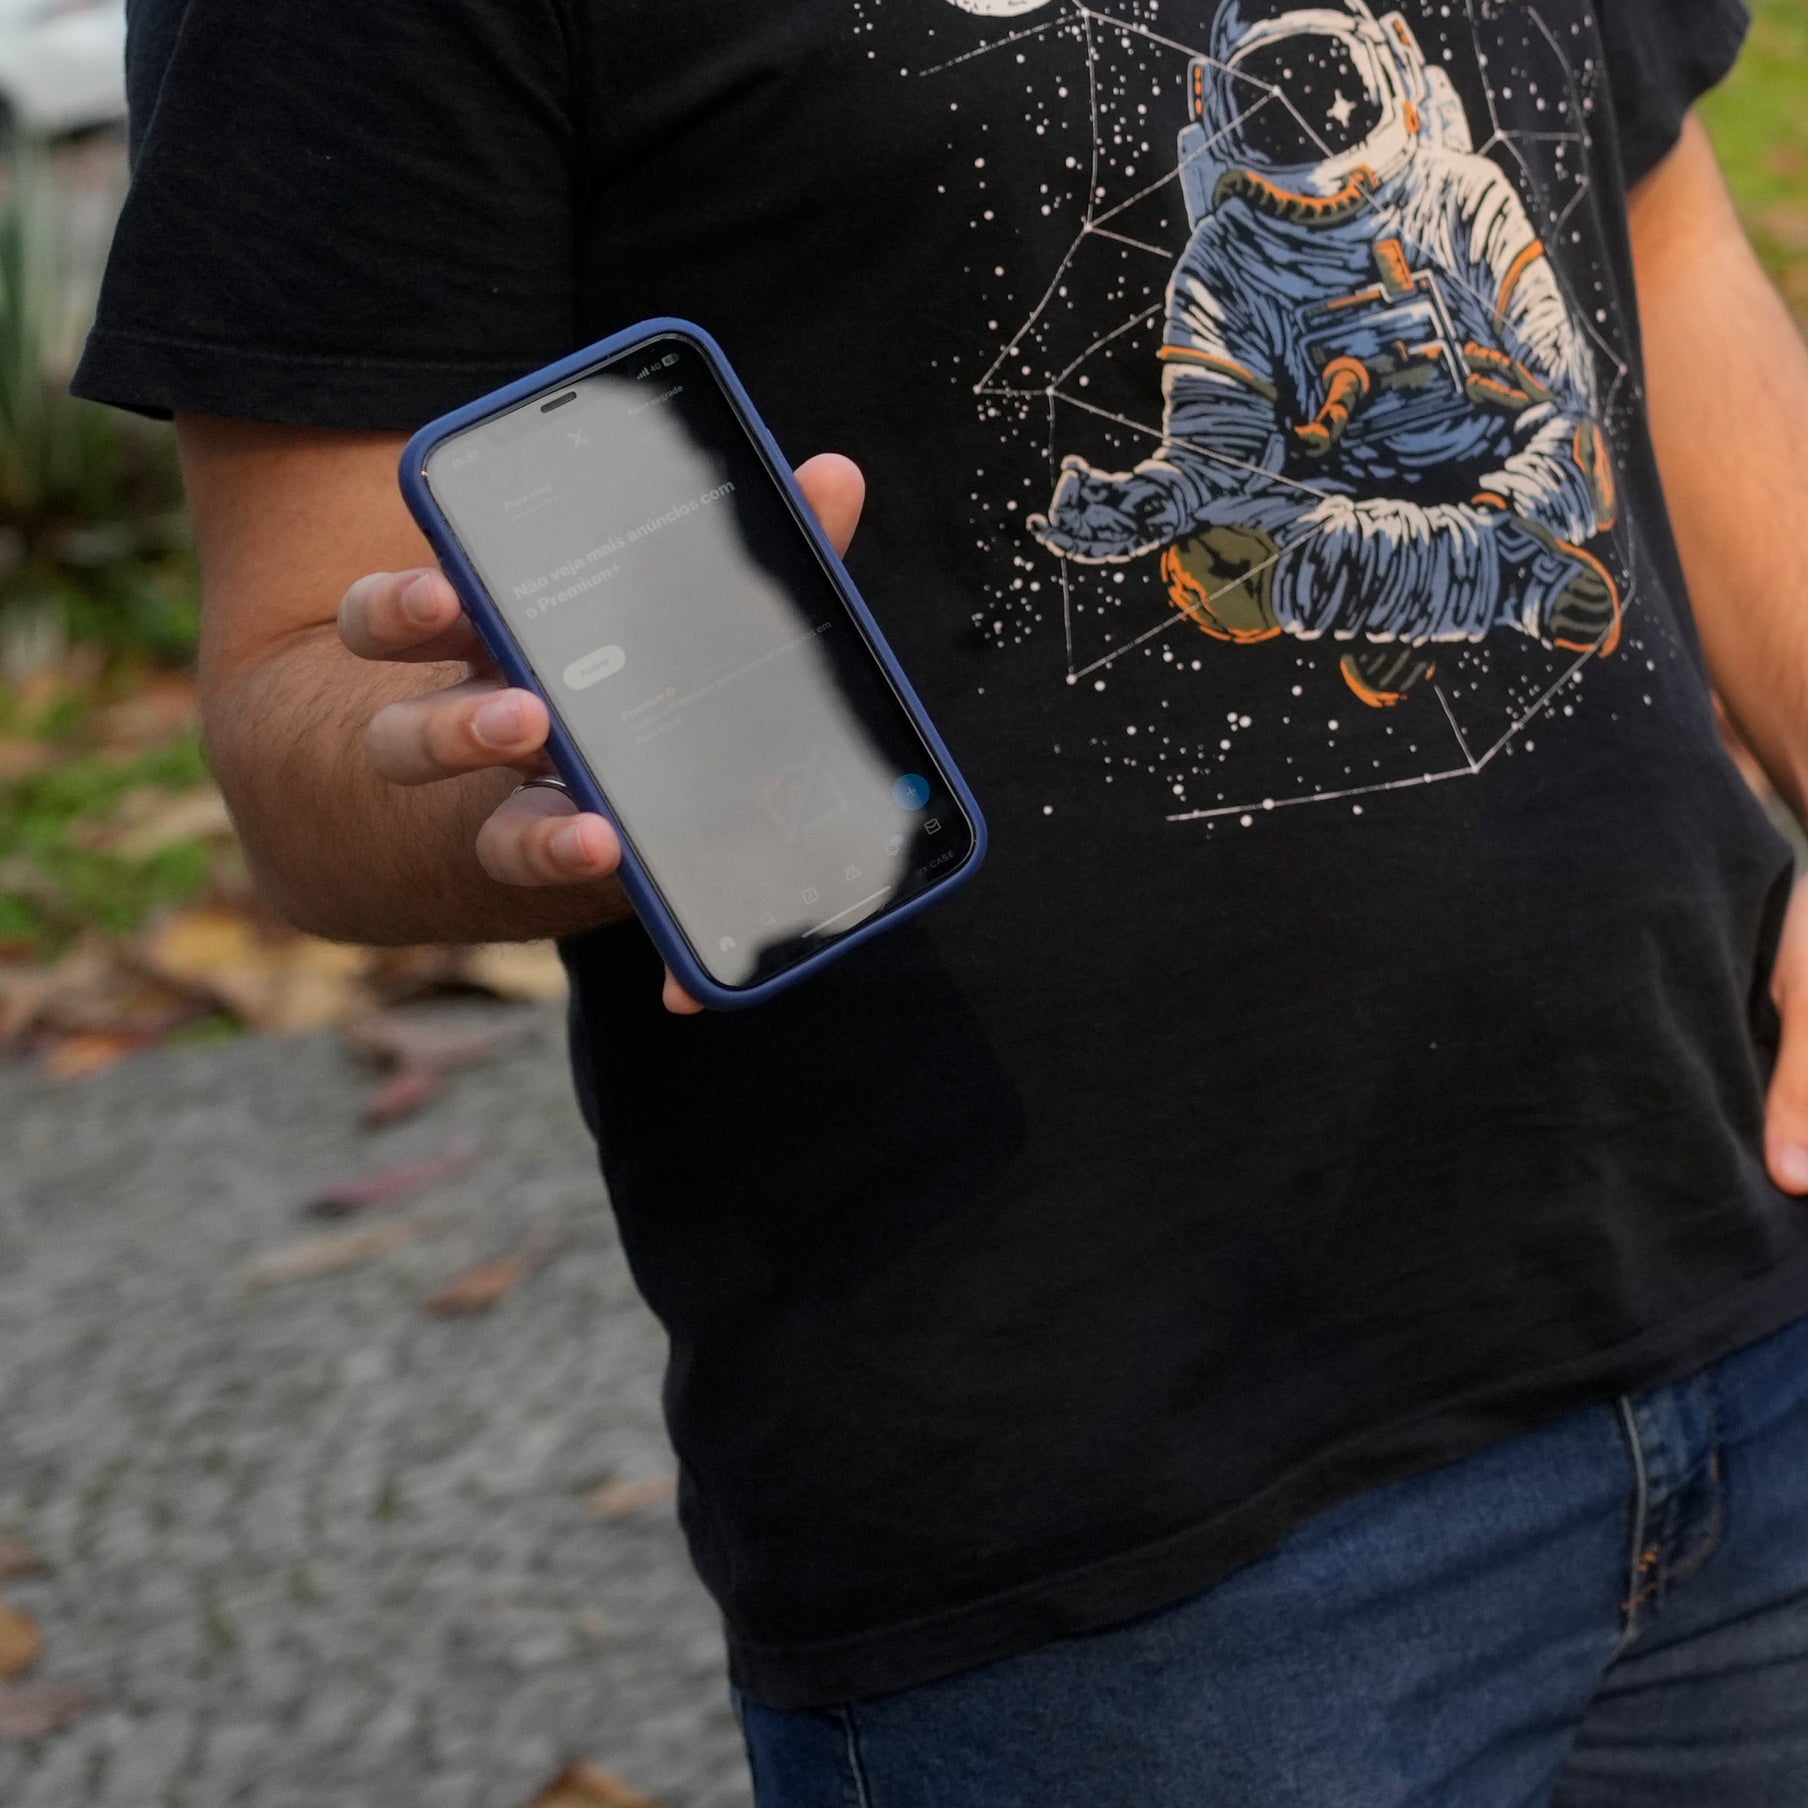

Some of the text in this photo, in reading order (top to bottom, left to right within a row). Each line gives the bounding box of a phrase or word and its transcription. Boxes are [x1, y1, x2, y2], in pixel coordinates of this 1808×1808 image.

[648, 383, 684, 407] upgrade
[511, 477, 736, 600] Não veja mais anúncios com
[524, 604, 539, 620] o
[815, 620, 832, 634] em
[927, 849, 955, 869] CASE
